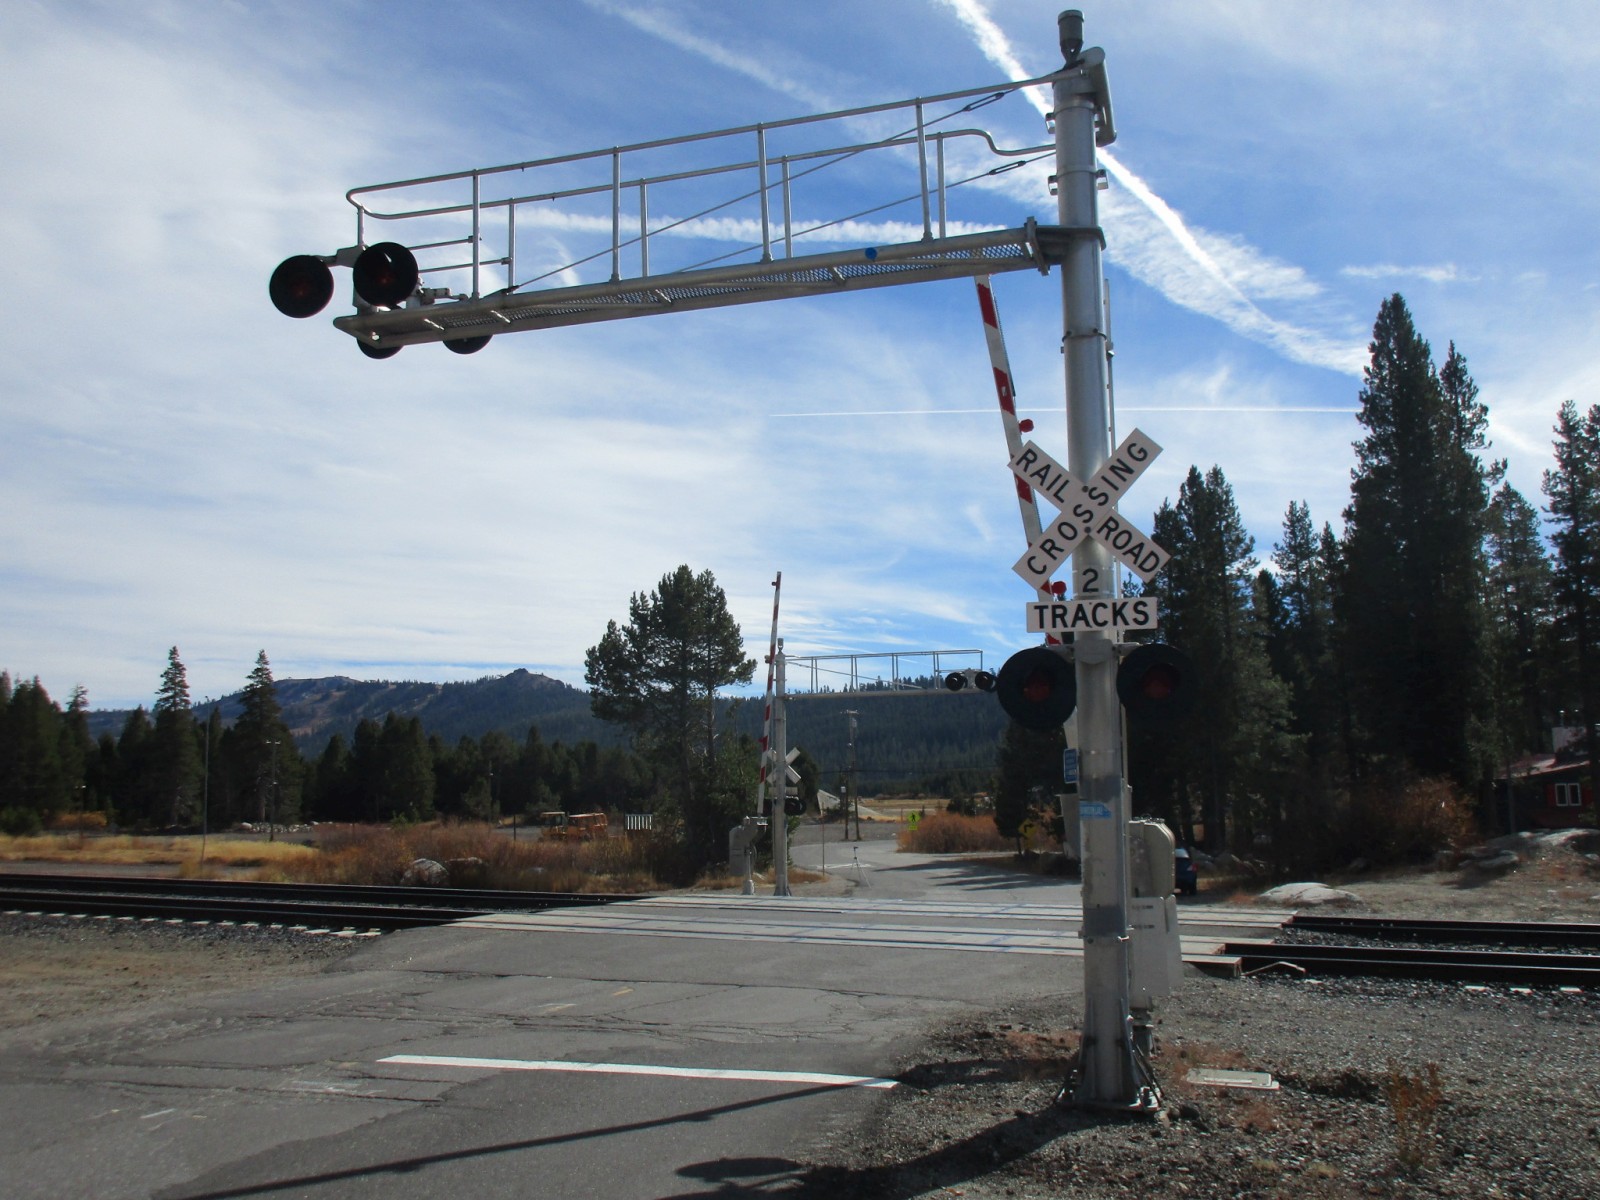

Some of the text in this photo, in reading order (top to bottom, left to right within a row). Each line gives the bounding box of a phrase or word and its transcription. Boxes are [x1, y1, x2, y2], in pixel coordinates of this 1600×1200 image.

[1016, 448, 1160, 574] RAIL ROAD
[1027, 442, 1149, 575] CROSSING
[1033, 601, 1149, 629] TRACKS
[1082, 568, 1099, 593] 2
